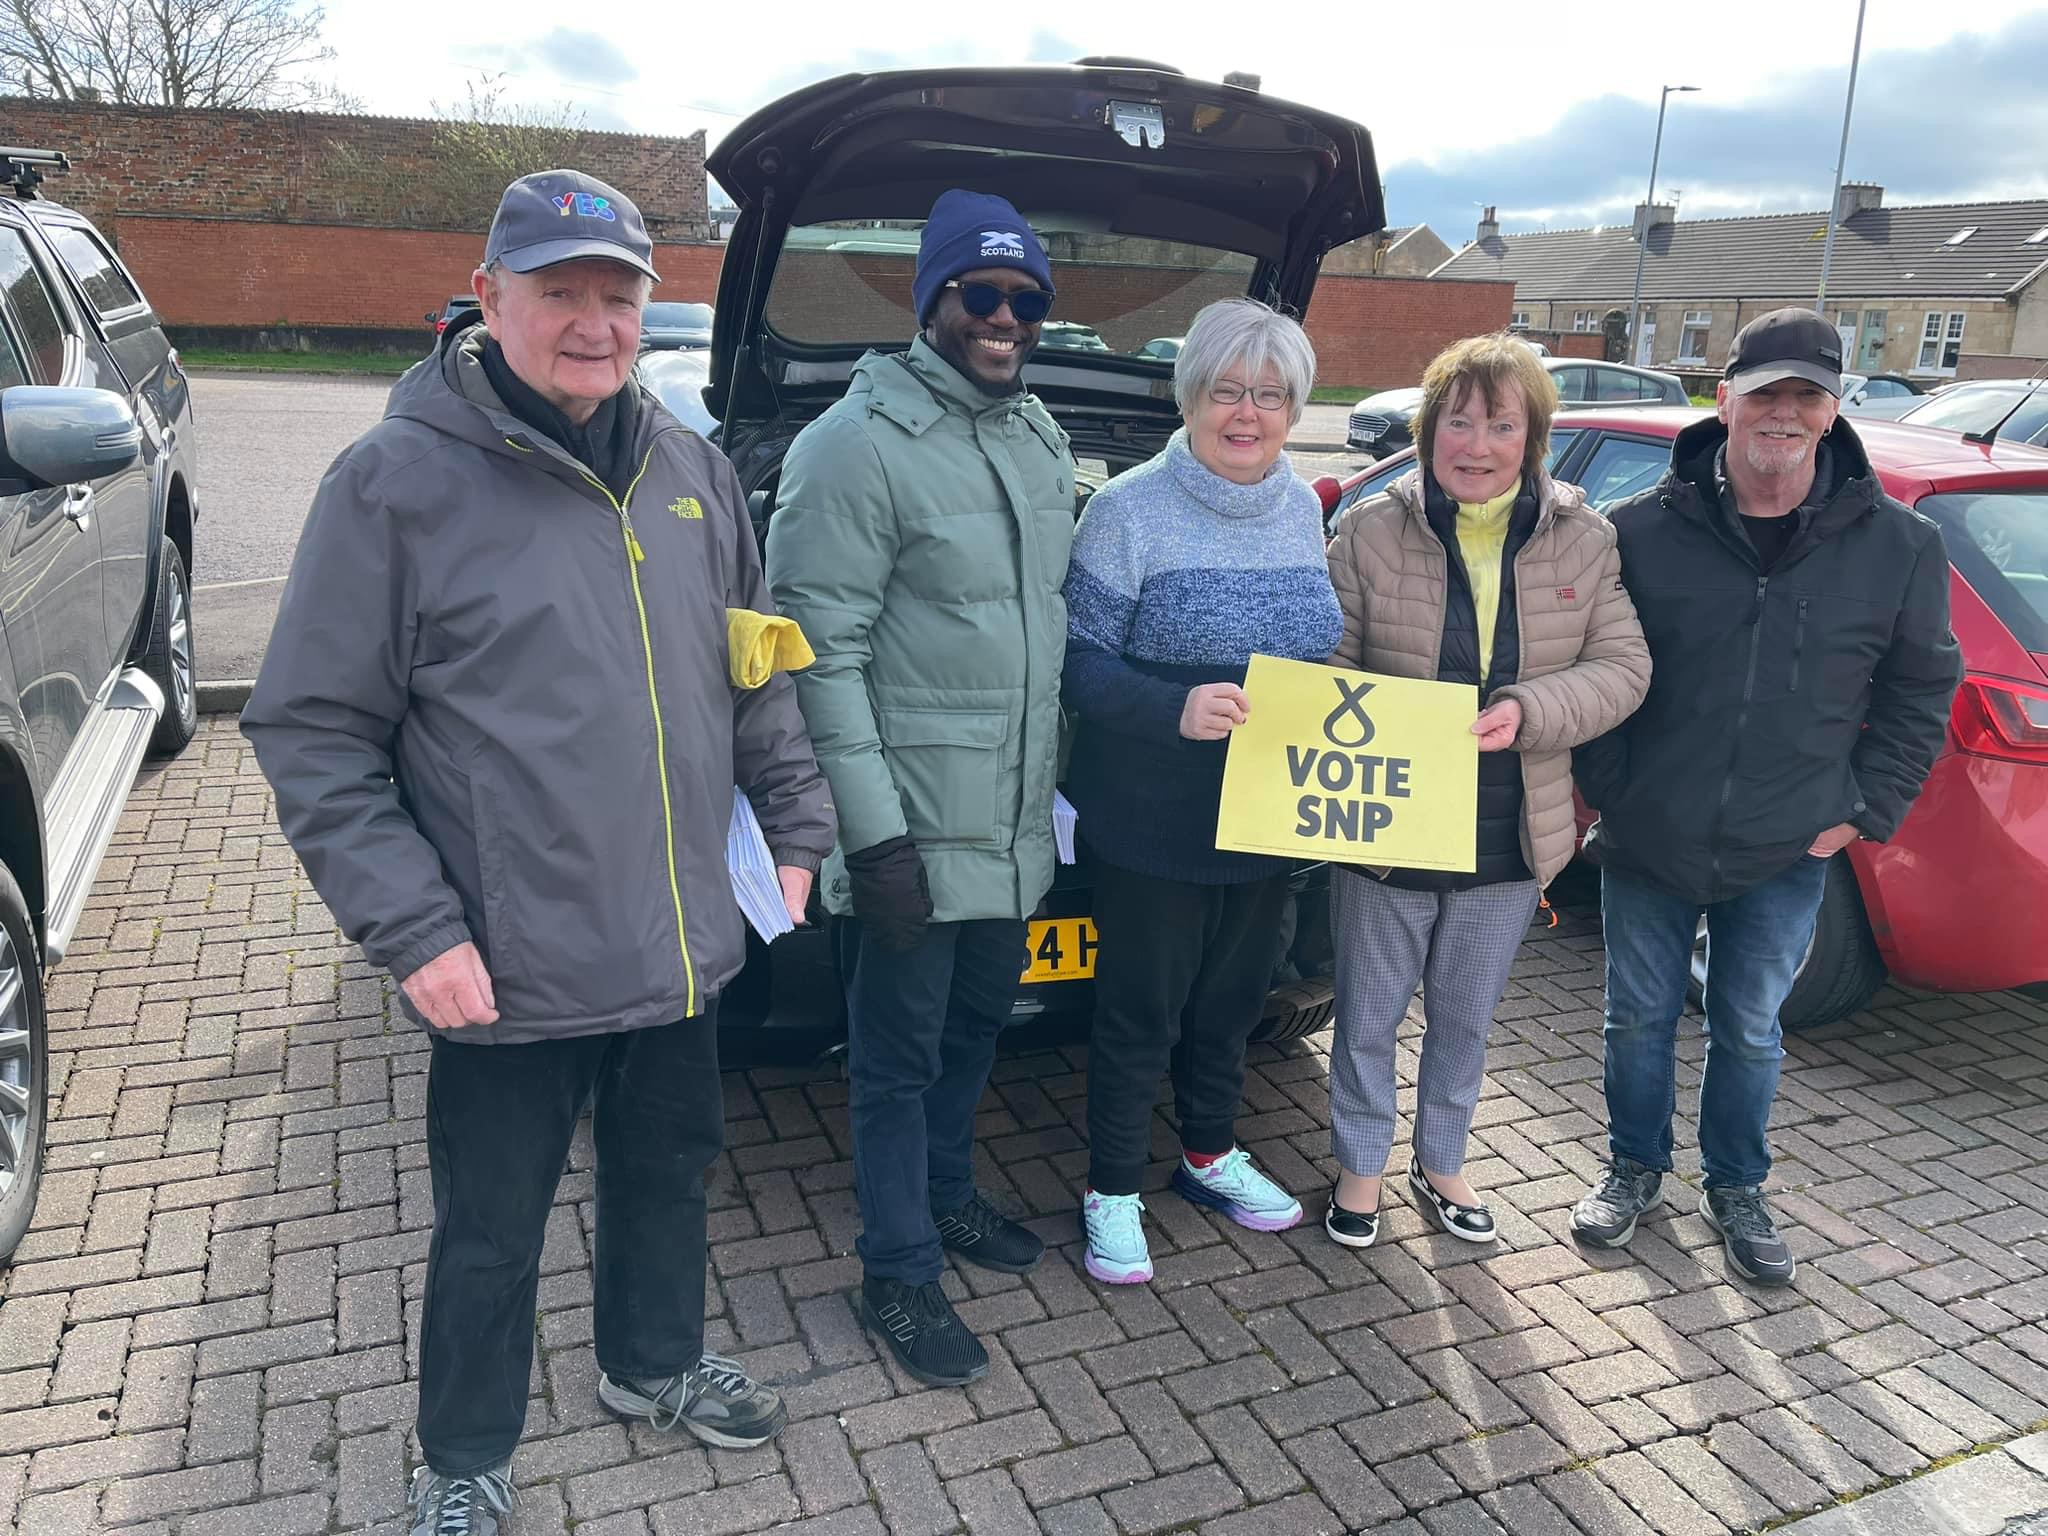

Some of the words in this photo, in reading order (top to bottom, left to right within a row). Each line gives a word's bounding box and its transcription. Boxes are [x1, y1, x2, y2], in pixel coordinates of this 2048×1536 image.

[552, 192, 615, 222] YES
[980, 247, 1024, 259] SCOTLAND
[675, 497, 690, 505] THE
[667, 504, 693, 512] NORTH
[677, 511, 695, 519] FACE
[1286, 745, 1412, 798] VOTE
[1295, 794, 1394, 843] SNP
